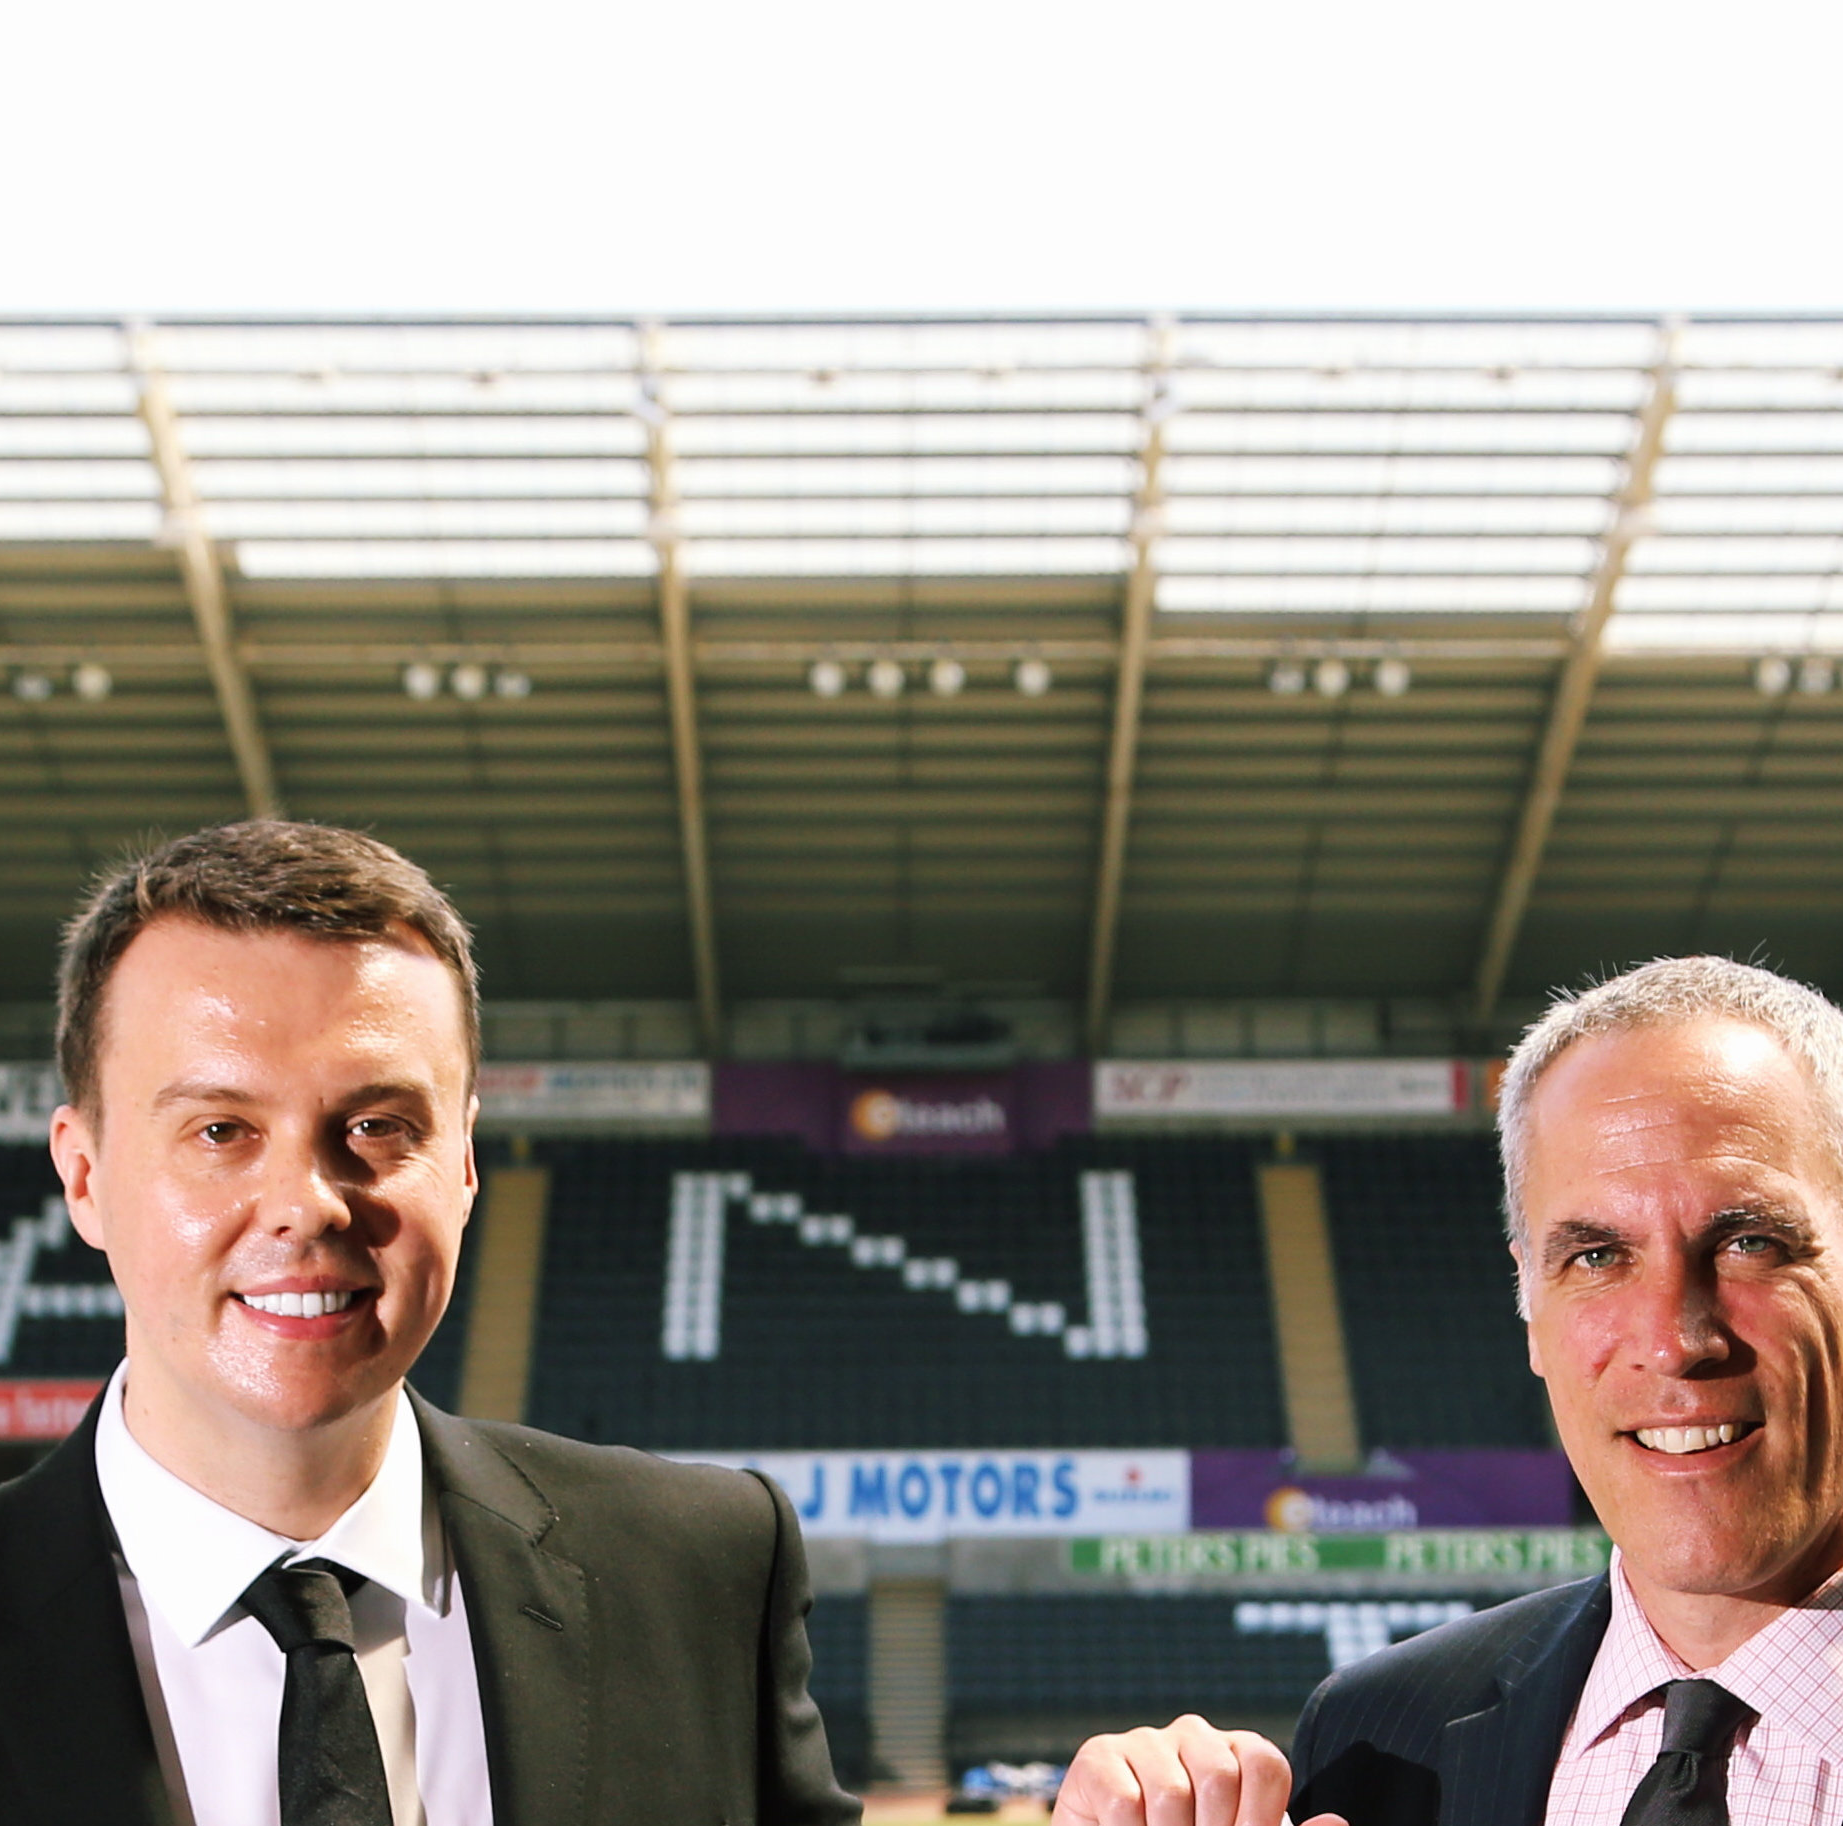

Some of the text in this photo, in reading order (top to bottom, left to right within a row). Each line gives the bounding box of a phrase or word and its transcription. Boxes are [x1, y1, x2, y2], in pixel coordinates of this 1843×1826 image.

[848, 1459, 1081, 1520] MOTORS
[1242, 1535, 1320, 1573] PIES
[1527, 1534, 1605, 1572] PIES
